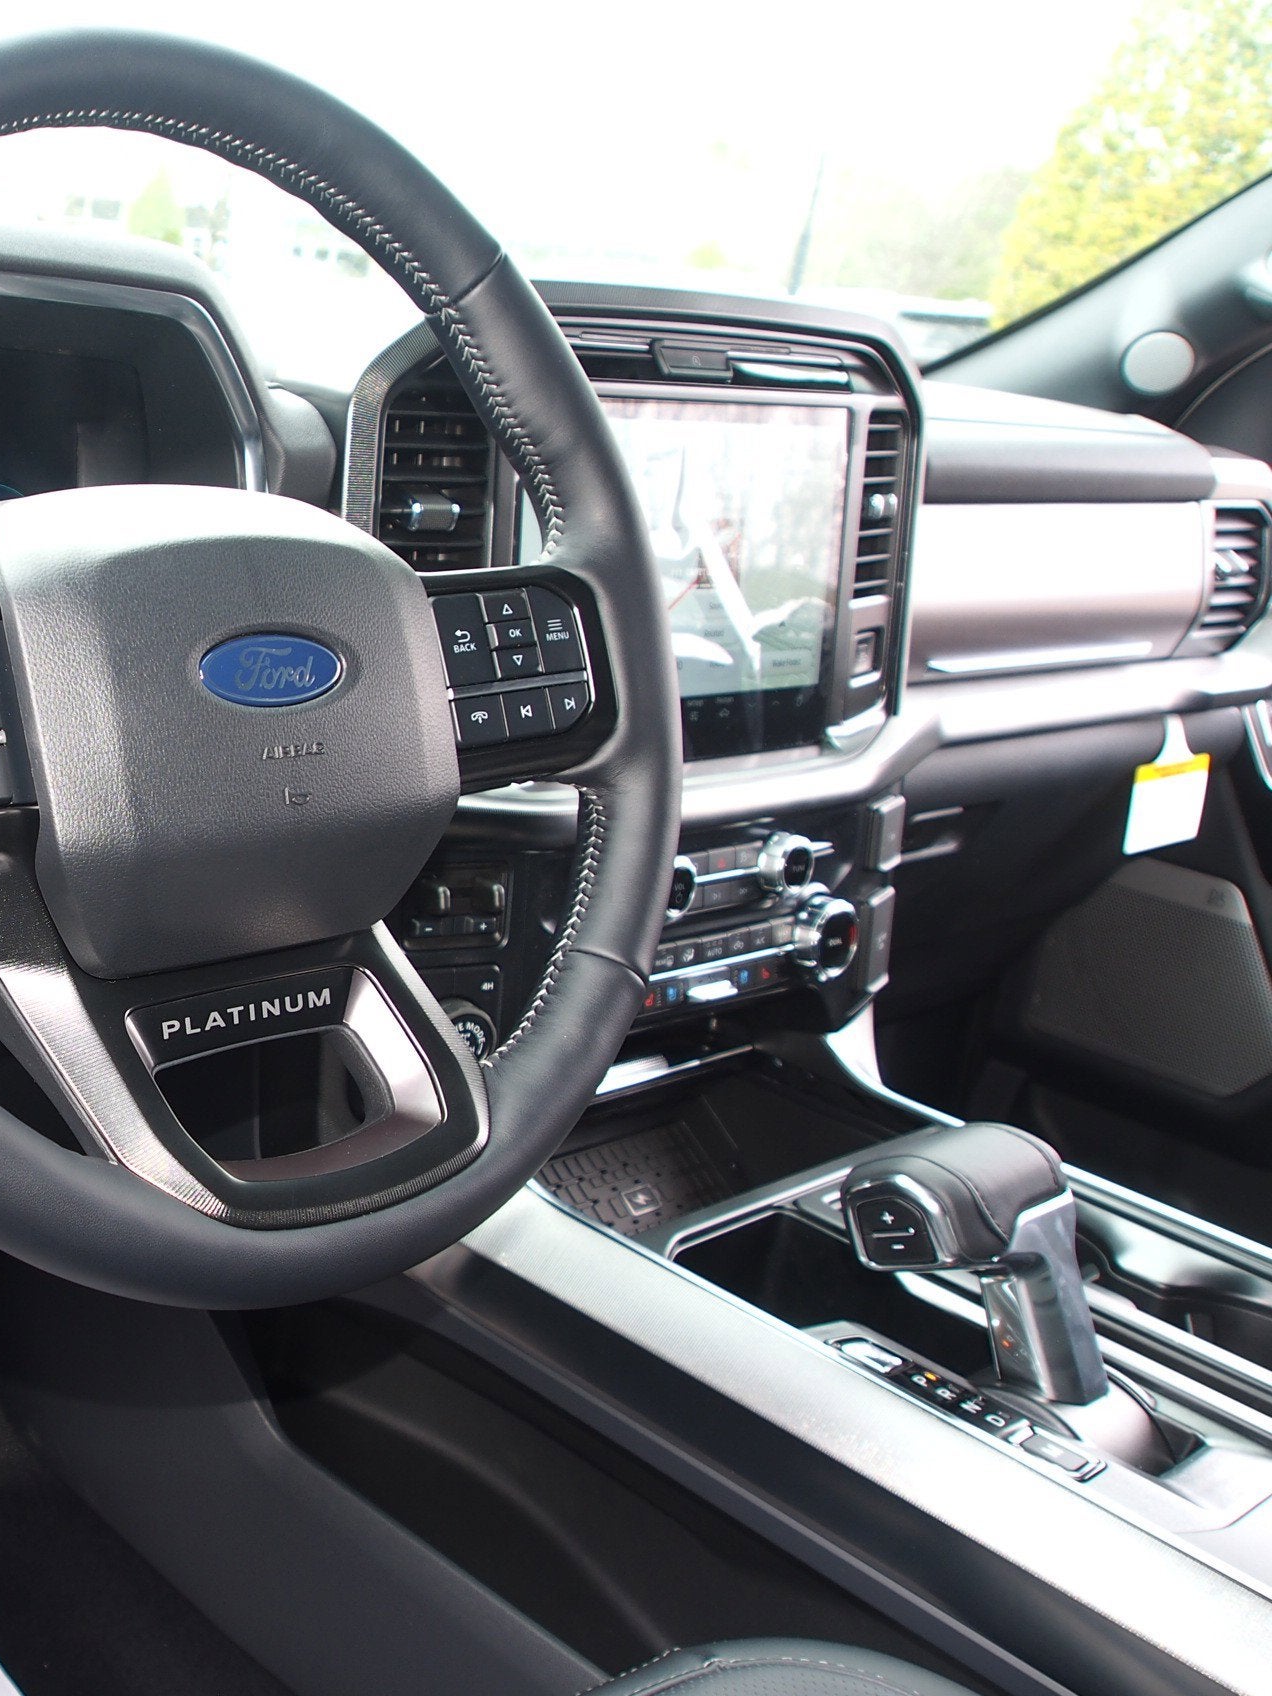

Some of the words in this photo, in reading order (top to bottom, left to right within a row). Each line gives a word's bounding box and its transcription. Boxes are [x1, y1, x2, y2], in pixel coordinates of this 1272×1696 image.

[508, 628, 522, 638] OK
[545, 631, 570, 642] MENU
[453, 642, 477, 654] BACK
[234, 646, 316, 691] Ford
[674, 883, 685, 892] VOL
[707, 947, 723, 957] AUTO
[482, 982, 494, 991] 4H
[161, 988, 332, 1041] PLATINUM
[911, 1373, 928, 1388] P
[935, 1386, 957, 1401] R
[984, 1413, 1006, 1428] D
